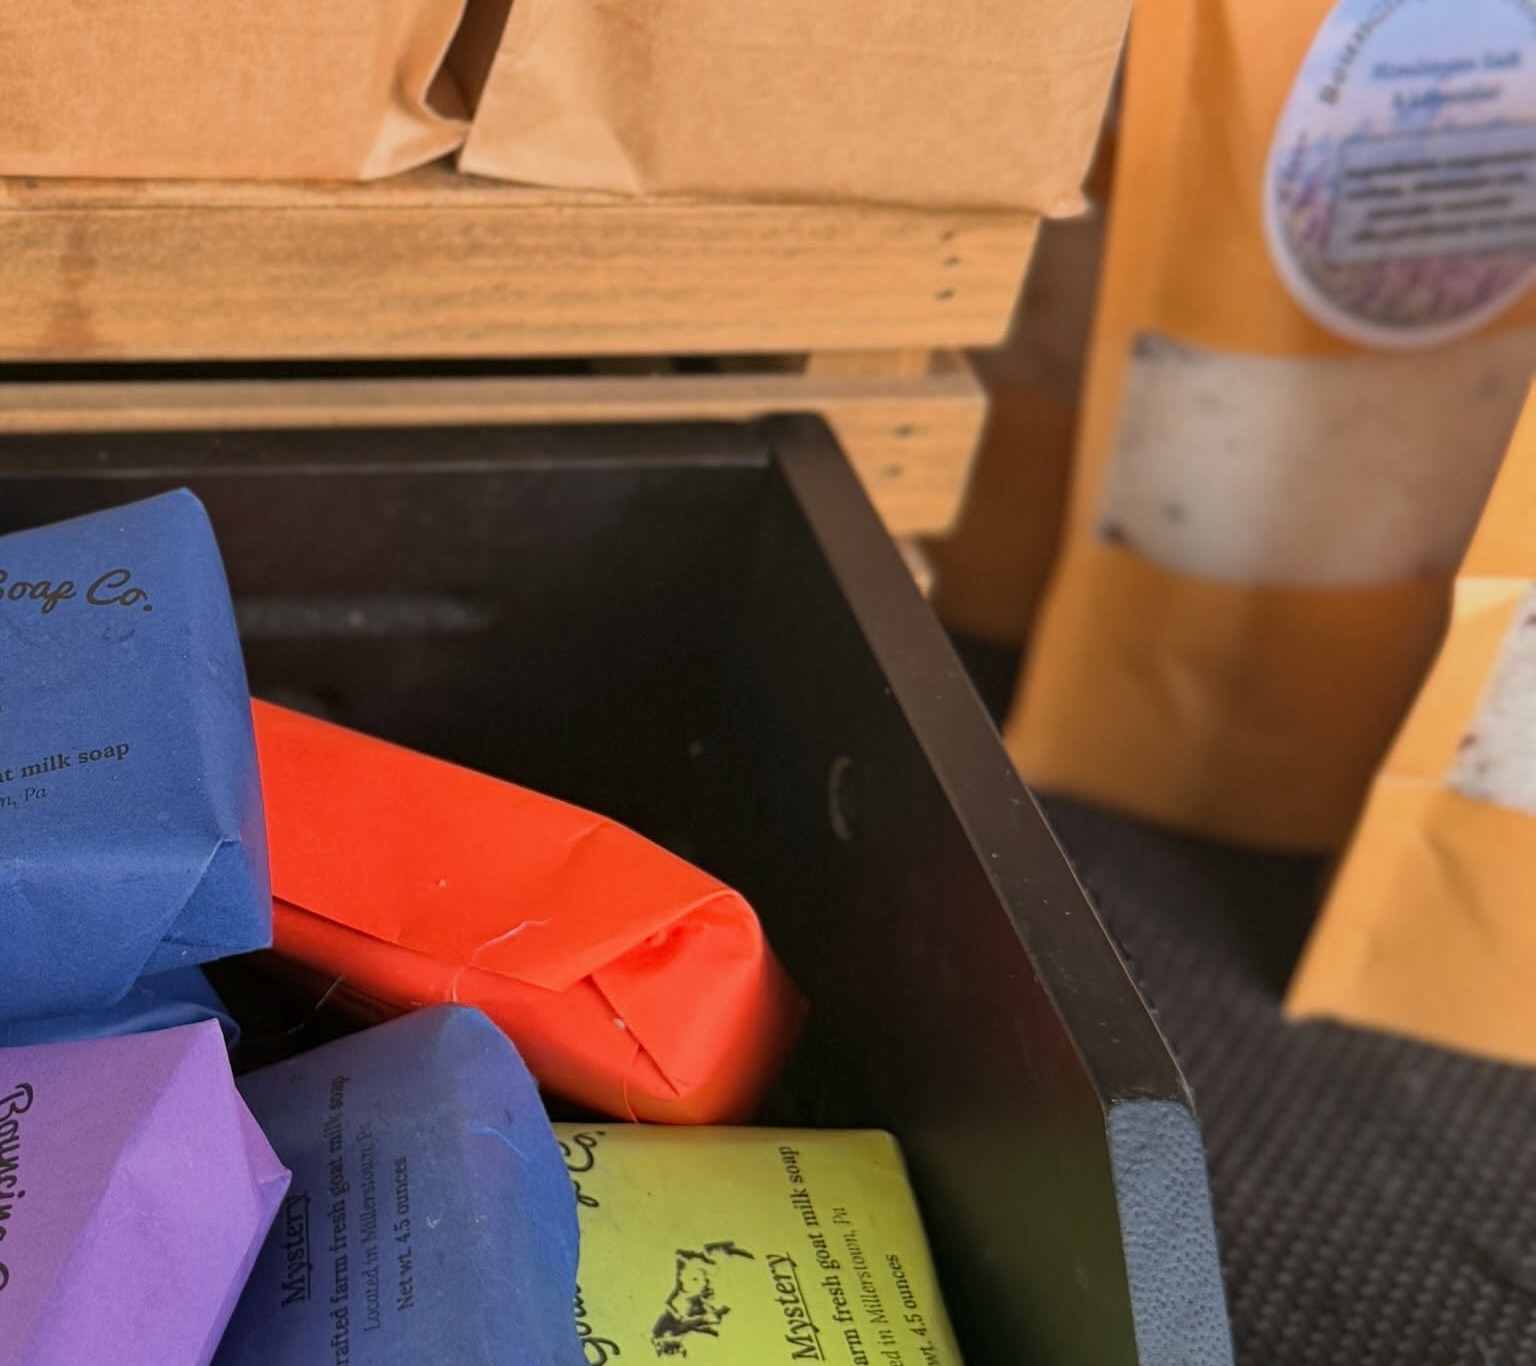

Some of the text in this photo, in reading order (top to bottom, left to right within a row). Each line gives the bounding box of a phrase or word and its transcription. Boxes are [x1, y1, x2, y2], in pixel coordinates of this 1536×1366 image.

[86, 569, 153, 611] Co.
[21, 755, 71, 780] milk
[78, 742, 130, 766] soap
[24, 786, 50, 801] Pa
[329, 1156, 350, 1196] goat
[779, 1146, 804, 1184] soap
[395, 1156, 409, 1215] ounces
[328, 1199, 347, 1251] fresh
[790, 1188, 819, 1226] milk
[281, 1189, 313, 1307] Mystery
[808, 1233, 840, 1270] goat
[330, 1255, 349, 1304] farm
[397, 1278, 413, 1311] Net
[822, 1275, 853, 1323] fresh
[885, 1254, 917, 1309] ounces
[766, 1252, 825, 1361] Mystery
[904, 1314, 927, 1336] 4.5
[877, 1329, 896, 1345] in
[920, 1340, 942, 1366] wt.
